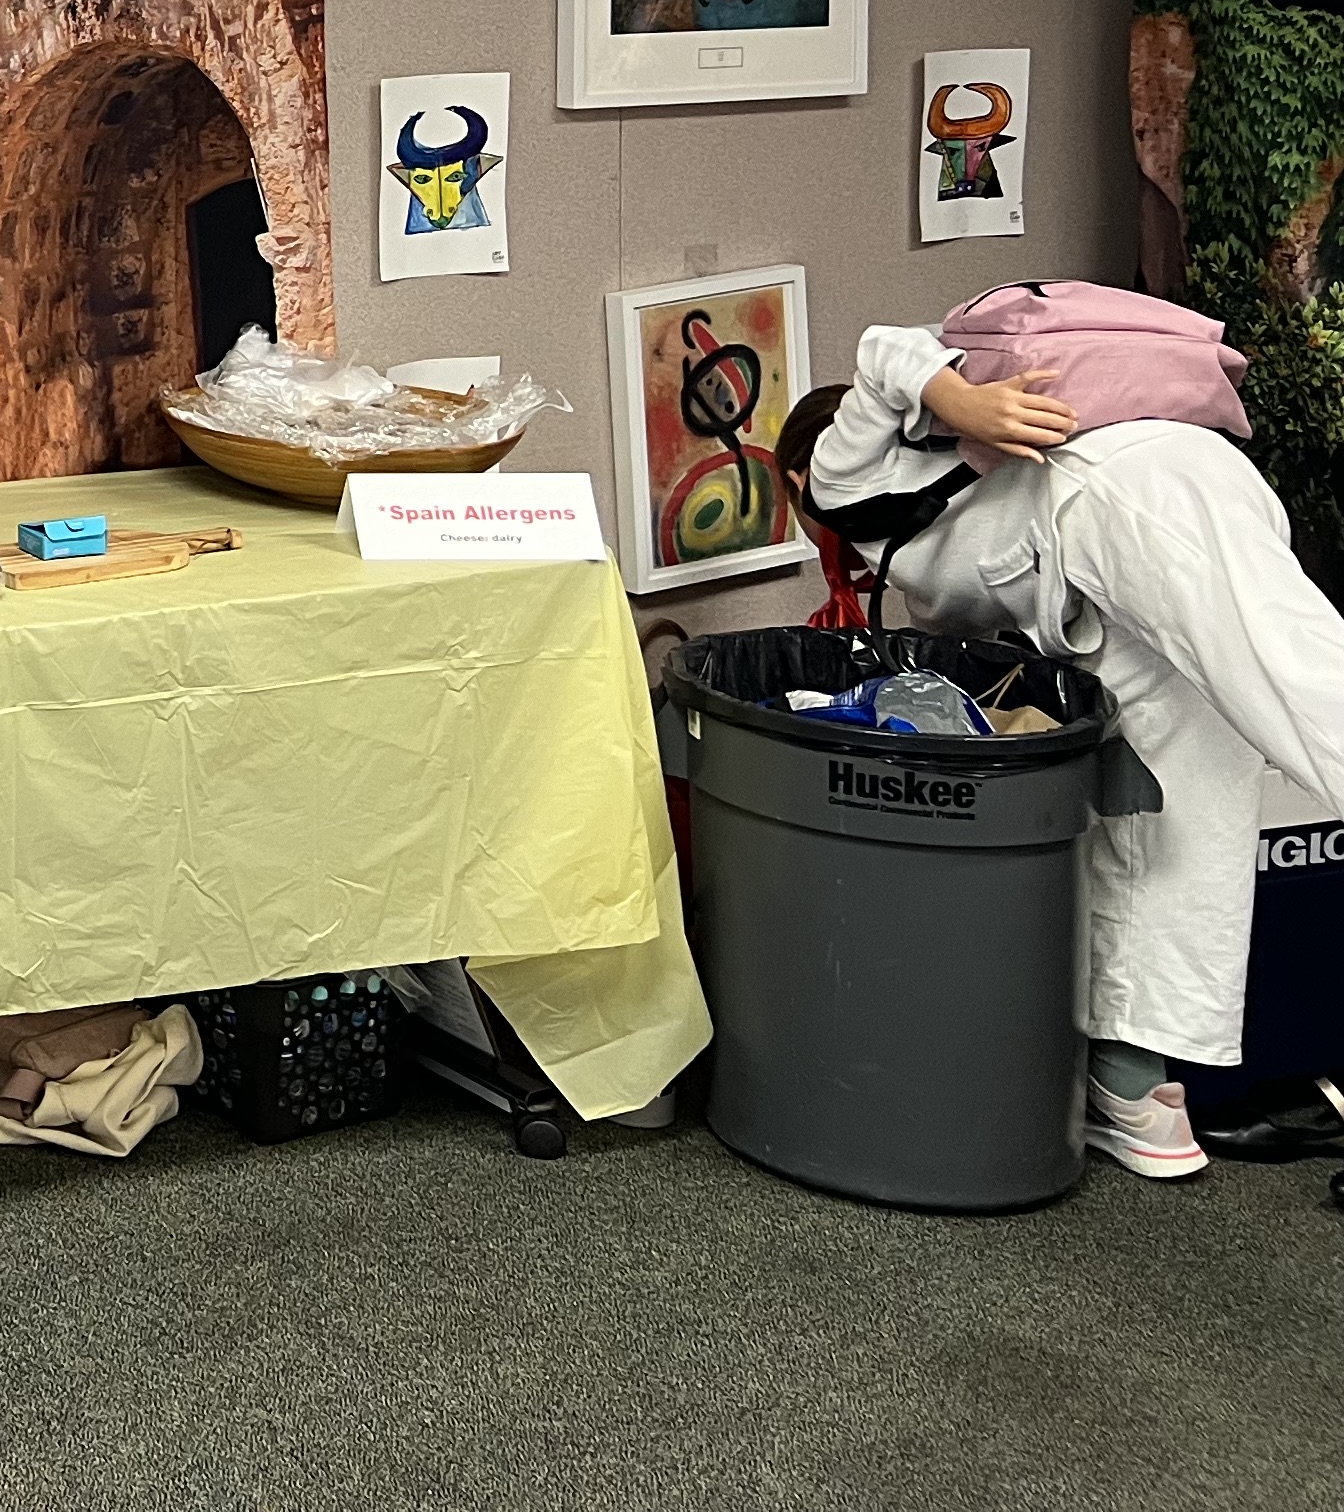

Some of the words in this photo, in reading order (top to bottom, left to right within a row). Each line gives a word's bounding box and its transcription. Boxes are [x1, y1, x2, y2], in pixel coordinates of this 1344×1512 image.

[464, 505, 575, 524] Allergens
[491, 533, 522, 544] dairy
[829, 759, 976, 809] Huskee
